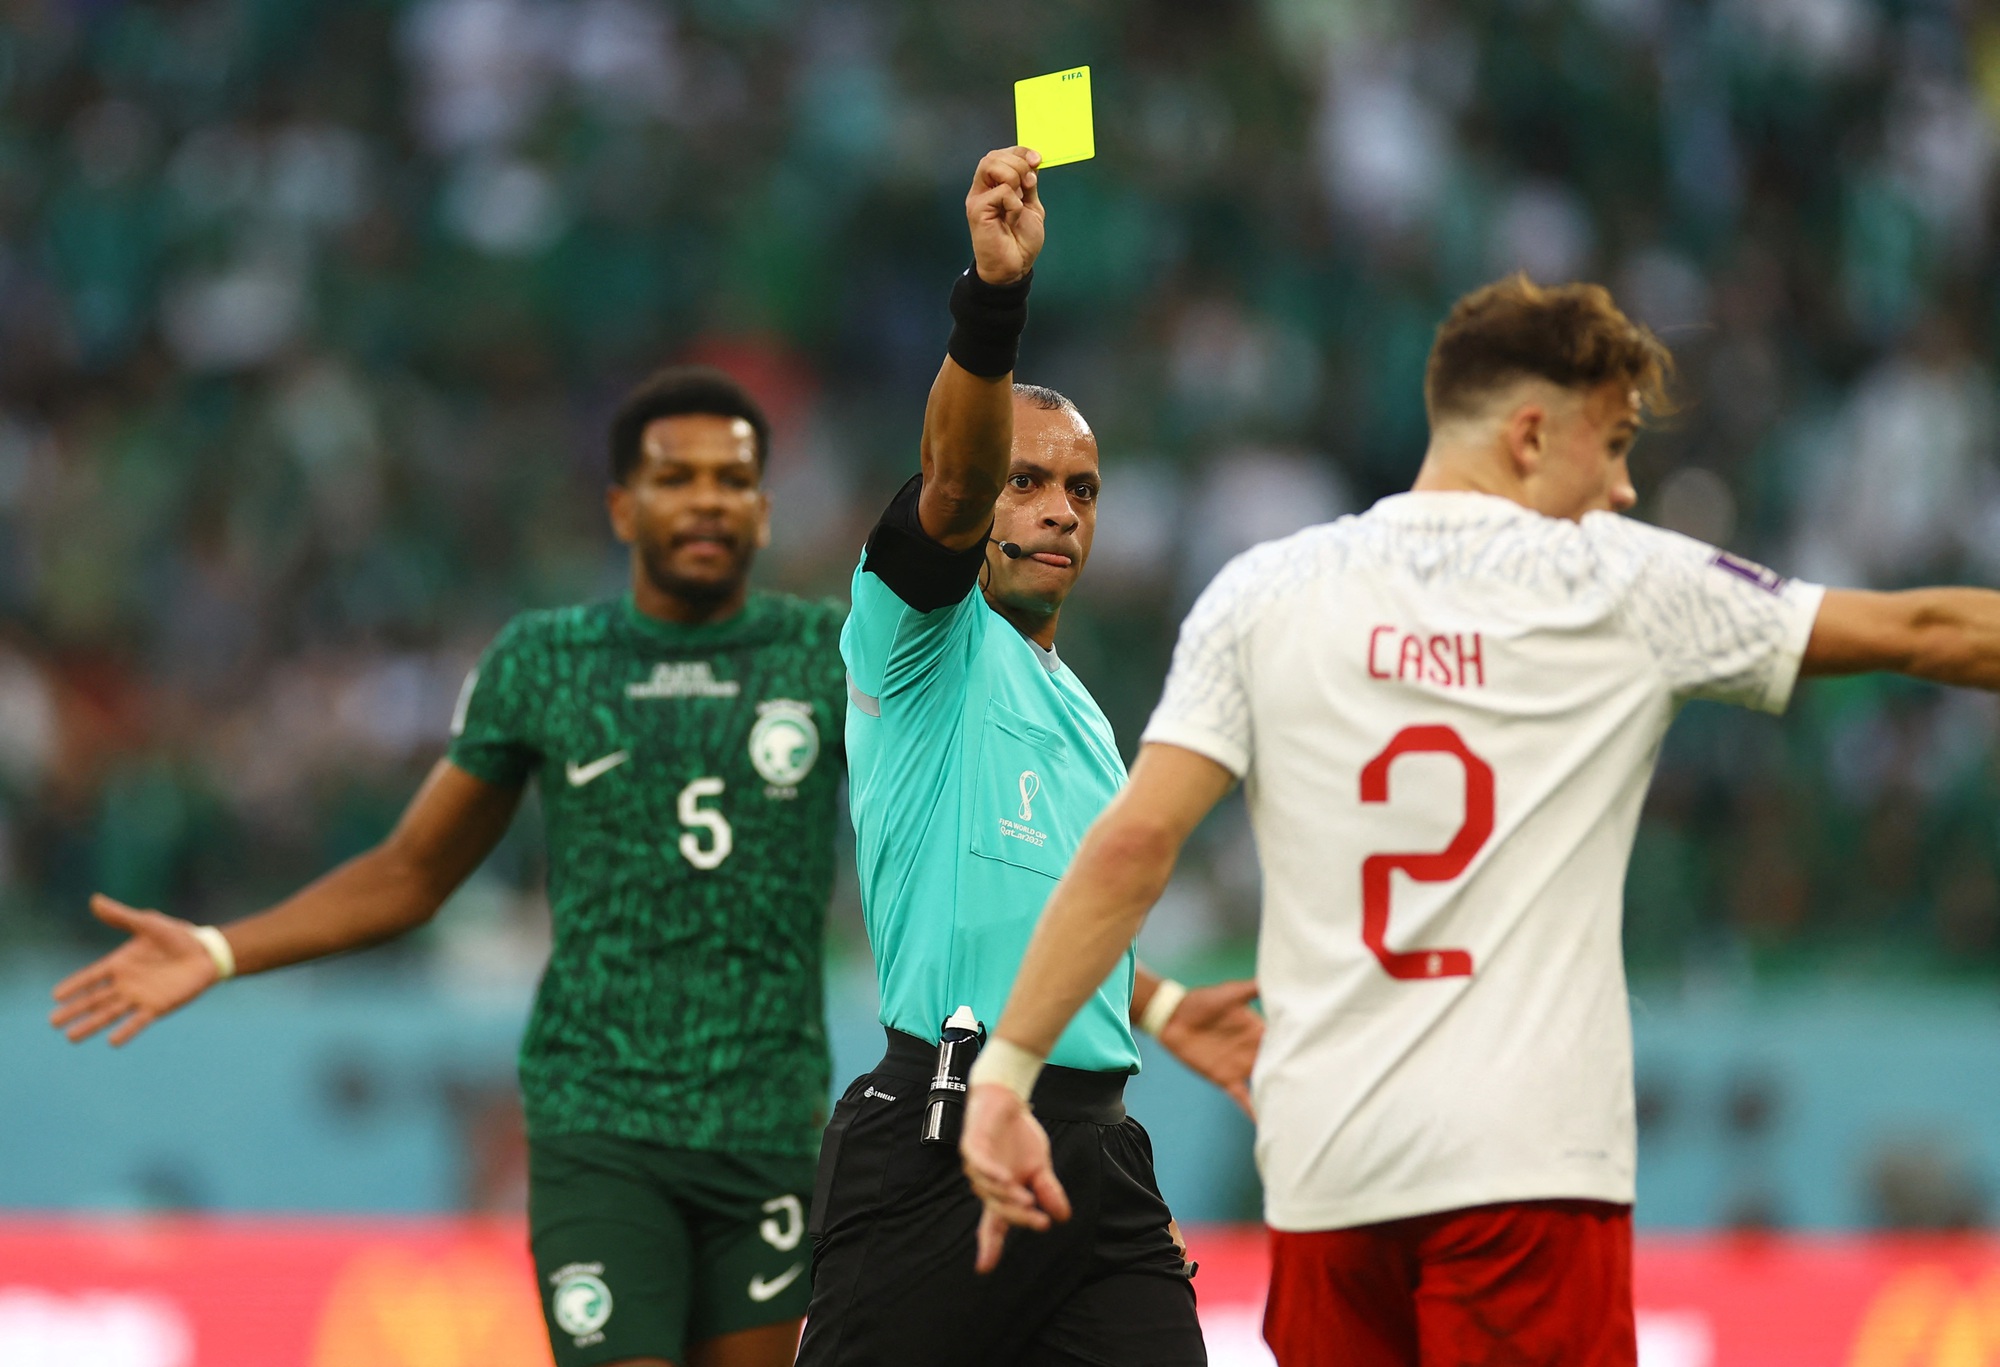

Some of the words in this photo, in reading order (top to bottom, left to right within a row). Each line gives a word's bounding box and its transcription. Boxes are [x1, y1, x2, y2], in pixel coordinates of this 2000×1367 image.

[1062, 72, 1083, 81] FIFA
[1367, 626, 1484, 687] CASH
[677, 777, 733, 869] 5
[999, 818, 1013, 828] FIFA
[1013, 822, 1035, 835] WORLD
[1035, 831, 1047, 840] CUP
[1360, 724, 1495, 981] 2
